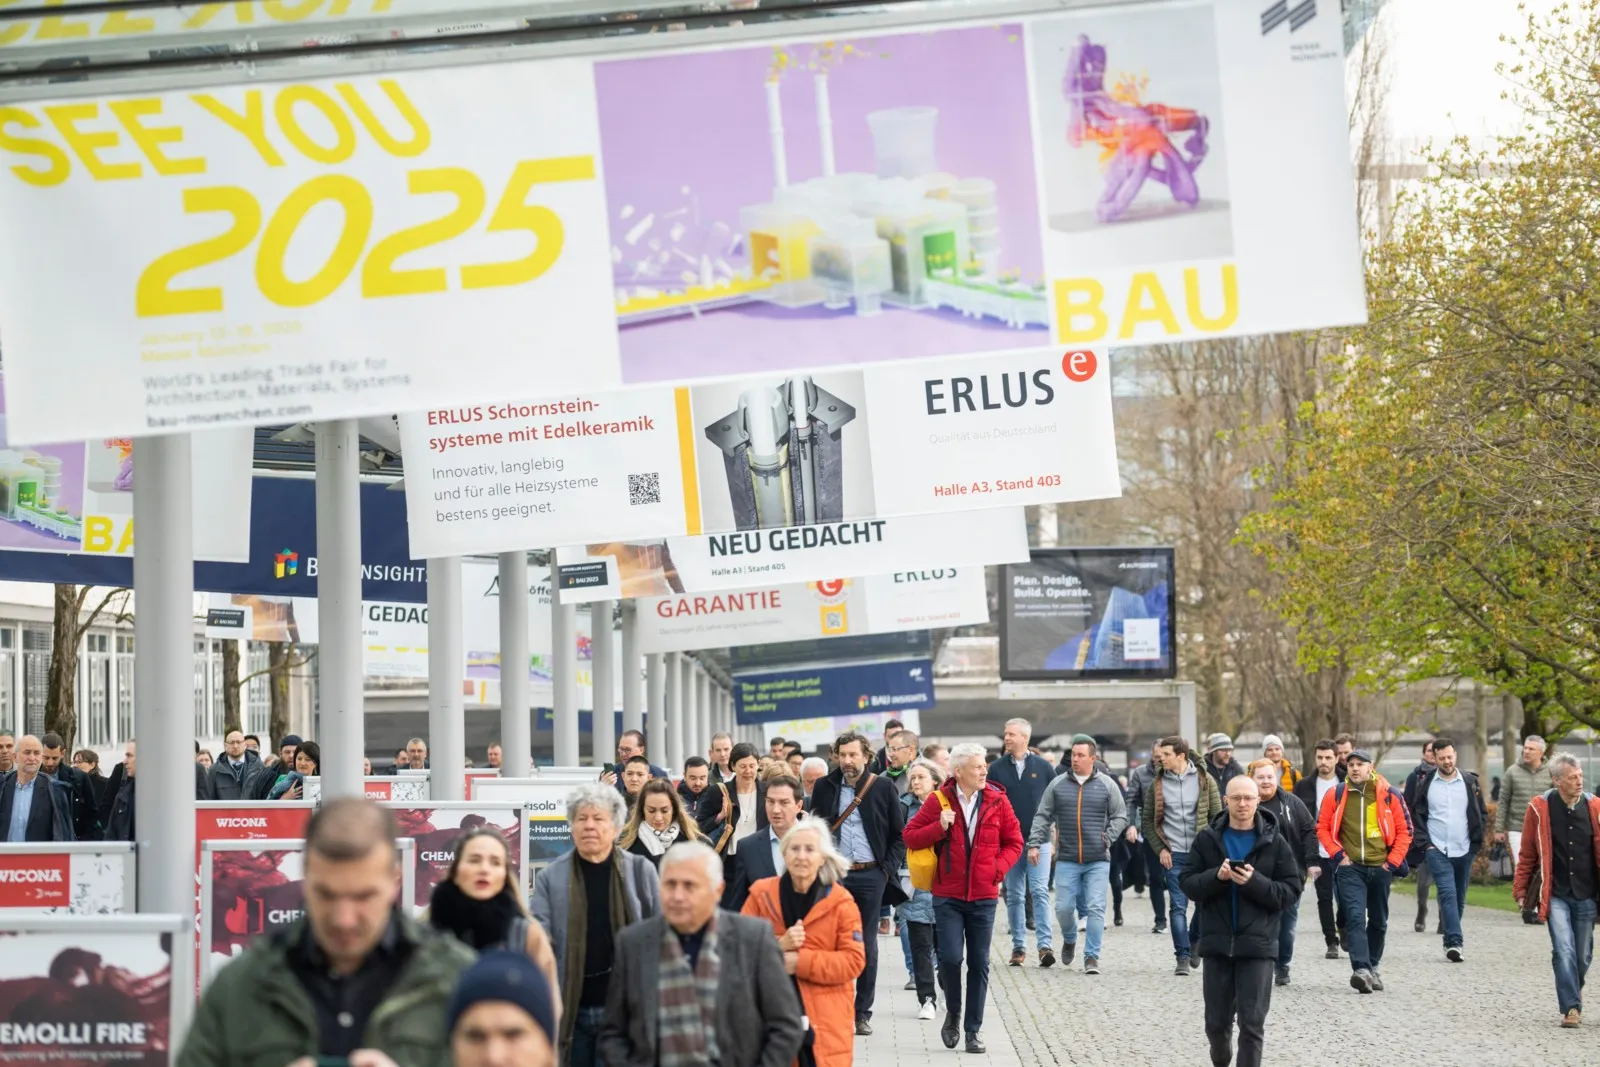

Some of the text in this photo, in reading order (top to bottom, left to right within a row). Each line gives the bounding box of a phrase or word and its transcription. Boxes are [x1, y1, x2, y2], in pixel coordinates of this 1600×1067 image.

[0, 79, 431, 188] SEE YOU
[135, 155, 595, 318] 2025
[1053, 265, 1240, 345] BAU
[211, 365, 273, 385] Leading
[279, 362, 324, 378] Trade
[330, 358, 359, 374] Fair
[364, 356, 388, 371] for
[257, 379, 338, 398] Materials,
[343, 373, 412, 393] Systems
[925, 368, 1055, 415] ERLUS
[147, 403, 313, 429] bau-muenchen.com
[427, 397, 600, 426] ERLUS Schornstein-
[429, 415, 655, 453] systeme mit Edelkeramik
[929, 422, 1058, 445] Qualität aus Deutschland
[432, 457, 565, 480] Innovativ, langlebig
[434, 475, 599, 501] und für alle Heizsysteme
[934, 474, 1062, 497] Halle A3, Stand 403
[436, 502, 556, 523] bestens geeignet.
[709, 520, 886, 557] NEU GEDACHT
[360, 564, 428, 583] NSIGHT
[711, 567, 731, 576] Halle
[732, 566, 743, 574] A3
[748, 563, 770, 574] Stand
[771, 562, 786, 571] 405
[1013, 574, 1082, 587] Plan. Design.
[656, 590, 782, 618] GARANTIE
[1013, 587, 1092, 600] Build. Operate.
[771, 689, 822, 700] construction
[796, 677, 821, 689] portal
[743, 702, 777, 713] industry
[216, 817, 268, 828] WICONA
[420, 851, 455, 862] CHEM
[96, 1022, 147, 1044] FIRE
